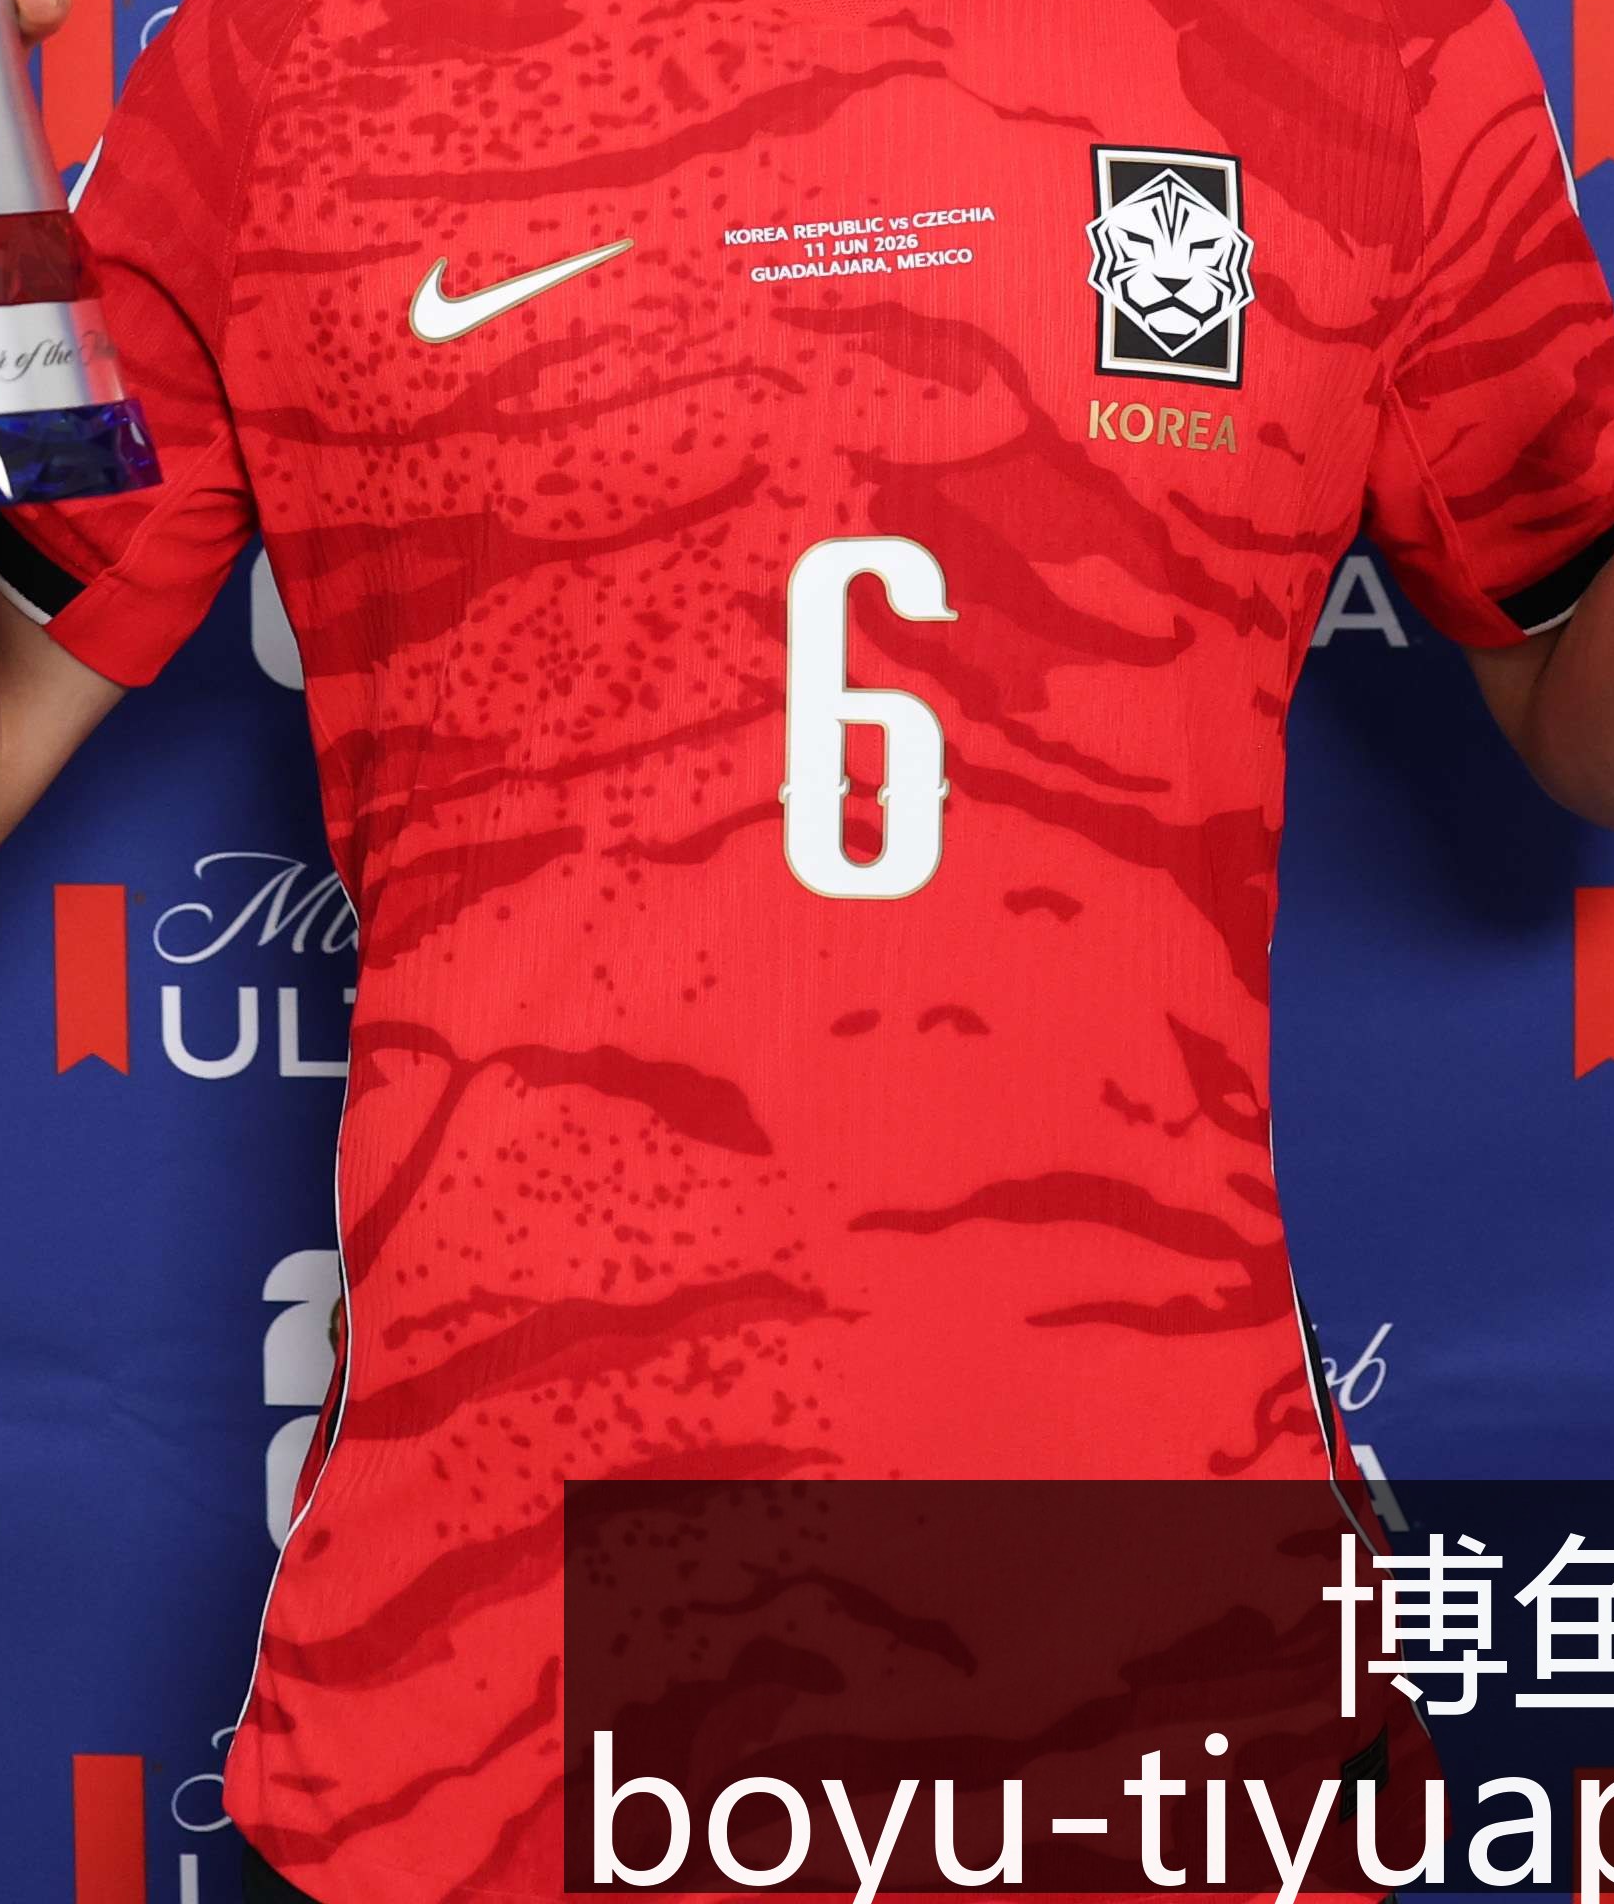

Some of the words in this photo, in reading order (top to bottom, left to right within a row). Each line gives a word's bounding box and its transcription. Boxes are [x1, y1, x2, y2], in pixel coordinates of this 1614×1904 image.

[724, 227, 789, 245] KOREA
[793, 216, 885, 240] REPUBLIC
[889, 217, 909, 230] vs
[912, 206, 996, 228] CZECHIA
[804, 242, 825, 258] 11
[832, 238, 869, 256] JUN
[874, 233, 919, 253] 2026
[750, 256, 893, 283] GUADALAJARA,
[897, 248, 973, 271] MEXICO
[1088, 400, 1238, 455] KOREA
[778, 535, 960, 900] 6
